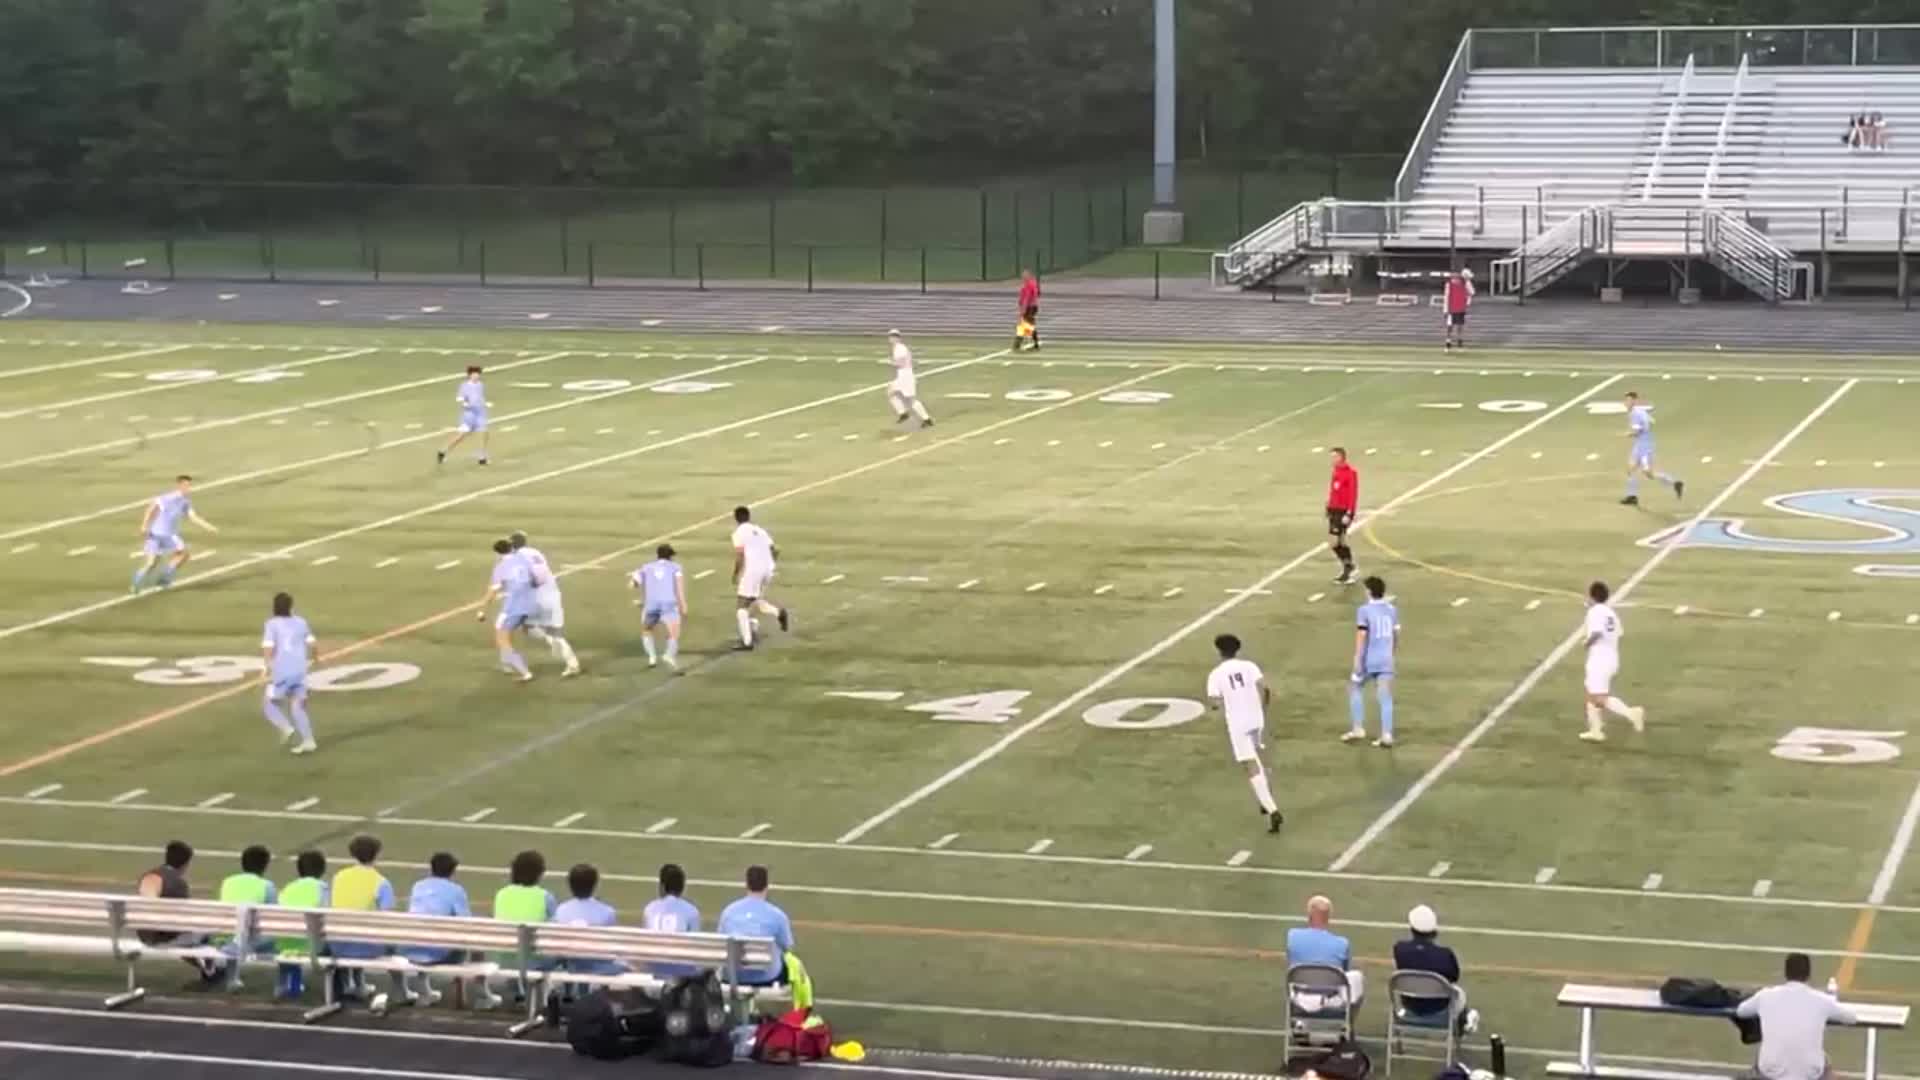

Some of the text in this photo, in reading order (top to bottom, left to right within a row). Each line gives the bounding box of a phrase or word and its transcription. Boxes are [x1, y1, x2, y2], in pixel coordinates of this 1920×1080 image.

[1375, 614, 1393, 639] 10
[1228, 671, 1246, 691] 19
[904, 690, 1206, 729] 40
[1770, 726, 1908, 763] 5
